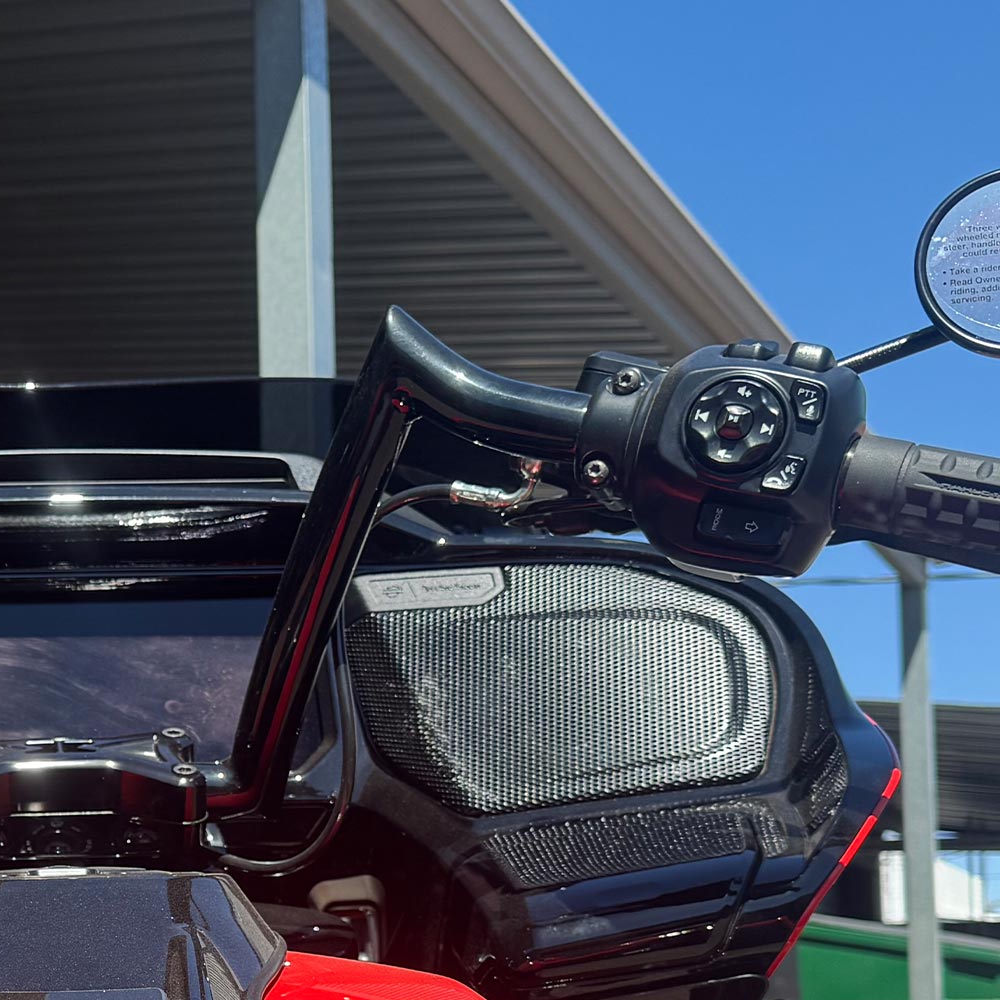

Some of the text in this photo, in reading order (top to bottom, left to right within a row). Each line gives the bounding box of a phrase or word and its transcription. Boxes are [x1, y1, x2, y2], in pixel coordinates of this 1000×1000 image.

[967, 225, 994, 233] Three
[956, 232, 994, 242] wheeled
[943, 244, 969, 252] steer,
[962, 248, 988, 258] could
[950, 267, 971, 276] Take
[950, 278, 973, 287] Read
[950, 287, 979, 296] riding,
[797, 387, 817, 399] PTT
